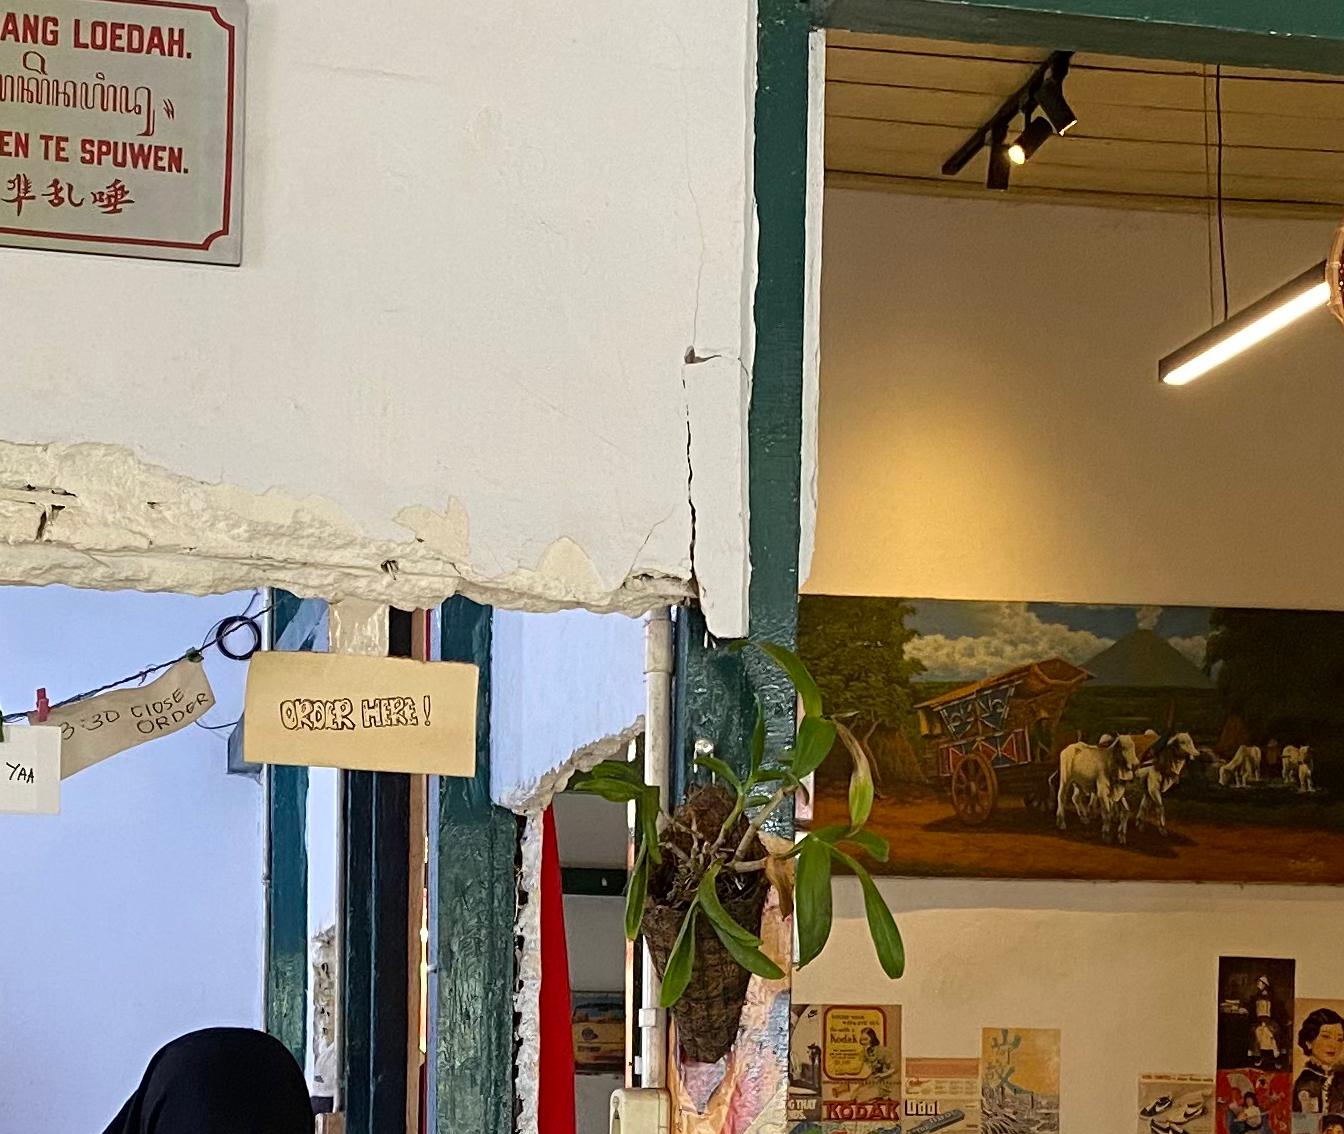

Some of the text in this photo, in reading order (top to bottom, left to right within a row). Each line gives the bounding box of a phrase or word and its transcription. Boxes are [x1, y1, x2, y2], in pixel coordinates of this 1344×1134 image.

[73, 18, 193, 60] LOEDAH.
[39, 134, 69, 164] TE
[80, 139, 189, 175] SPUWEN.
[136, 691, 211, 735] ORDER
[279, 698, 356, 731] ORDER
[5, 761, 36, 785] YAA
[825, 1102, 900, 1121] KODAK
